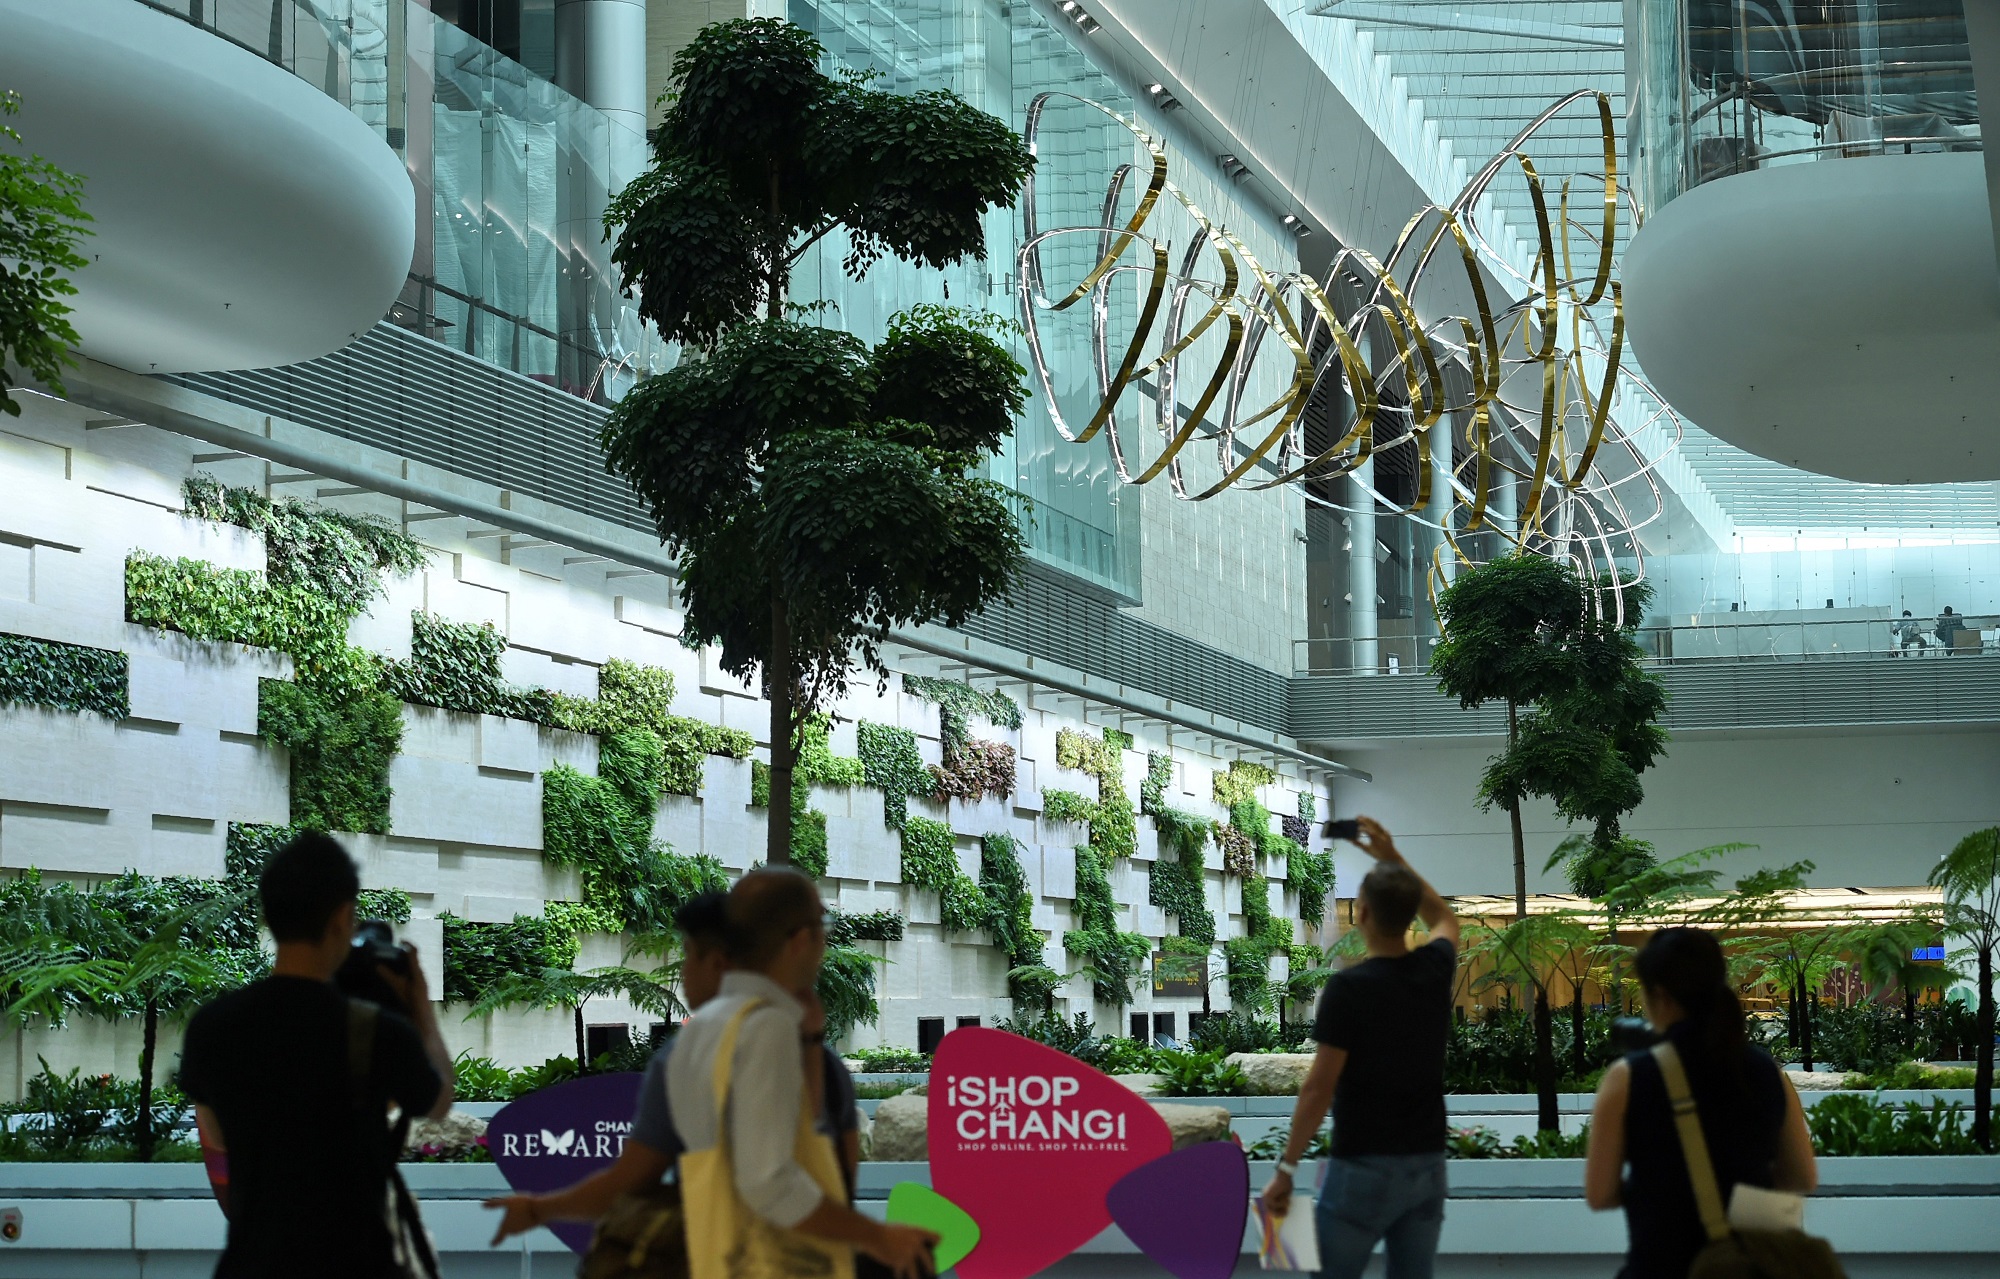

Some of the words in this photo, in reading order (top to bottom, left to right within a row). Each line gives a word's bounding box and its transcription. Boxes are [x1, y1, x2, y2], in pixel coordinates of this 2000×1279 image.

[947, 1075, 1080, 1107] iSHOP
[594, 1120, 635, 1133] CHAN
[956, 1109, 1127, 1140] CHANGI
[957, 1143, 986, 1151] SHOP
[991, 1143, 1034, 1151] ONLINE.
[1039, 1143, 1068, 1151] SHOP
